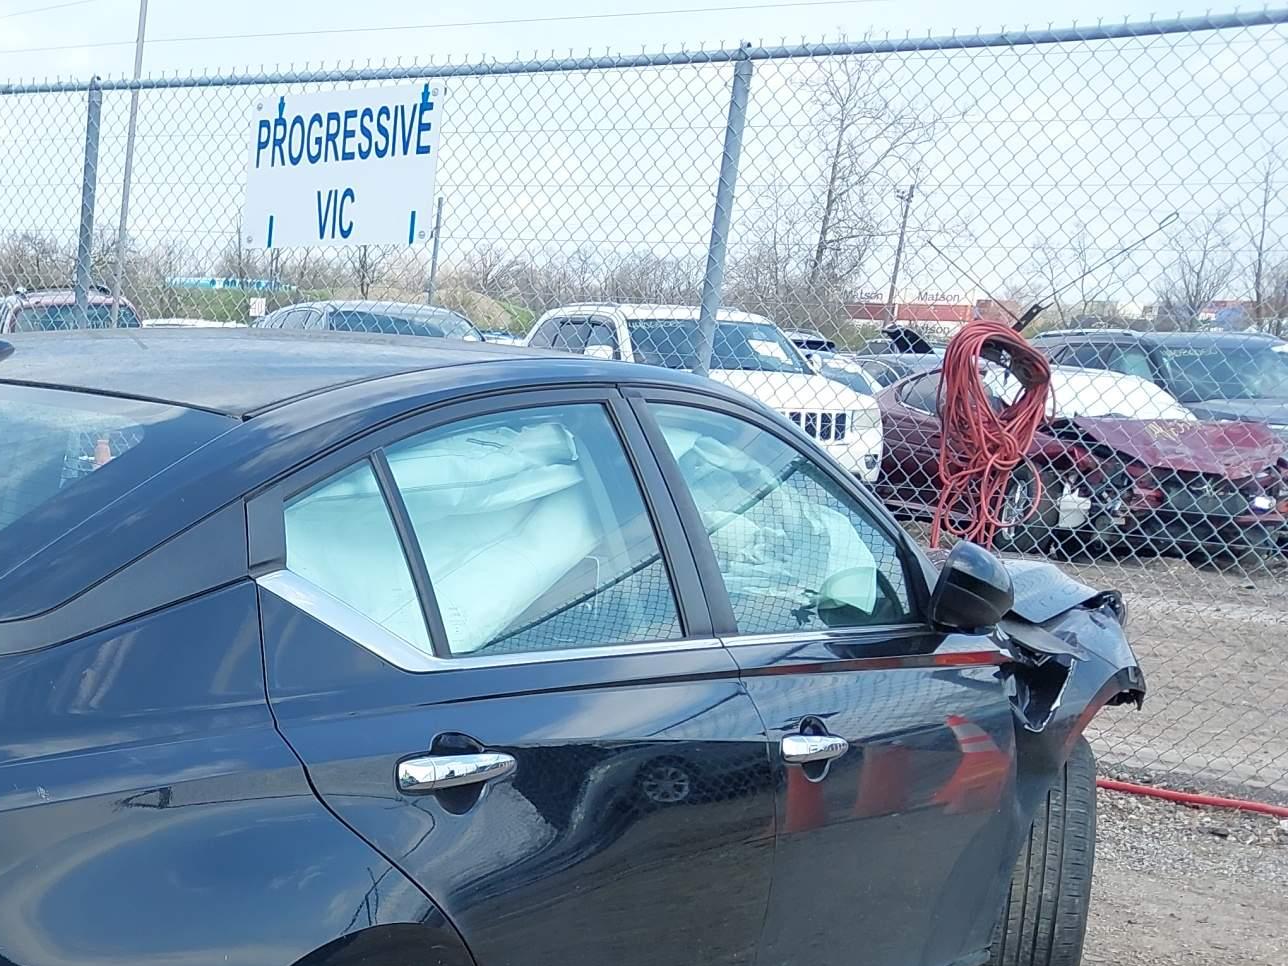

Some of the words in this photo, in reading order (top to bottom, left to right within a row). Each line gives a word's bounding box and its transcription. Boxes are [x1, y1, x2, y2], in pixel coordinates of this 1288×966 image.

[255, 101, 434, 169] PROGRESSIVE
[316, 187, 356, 240] VIC
[917, 291, 960, 303] Matson
